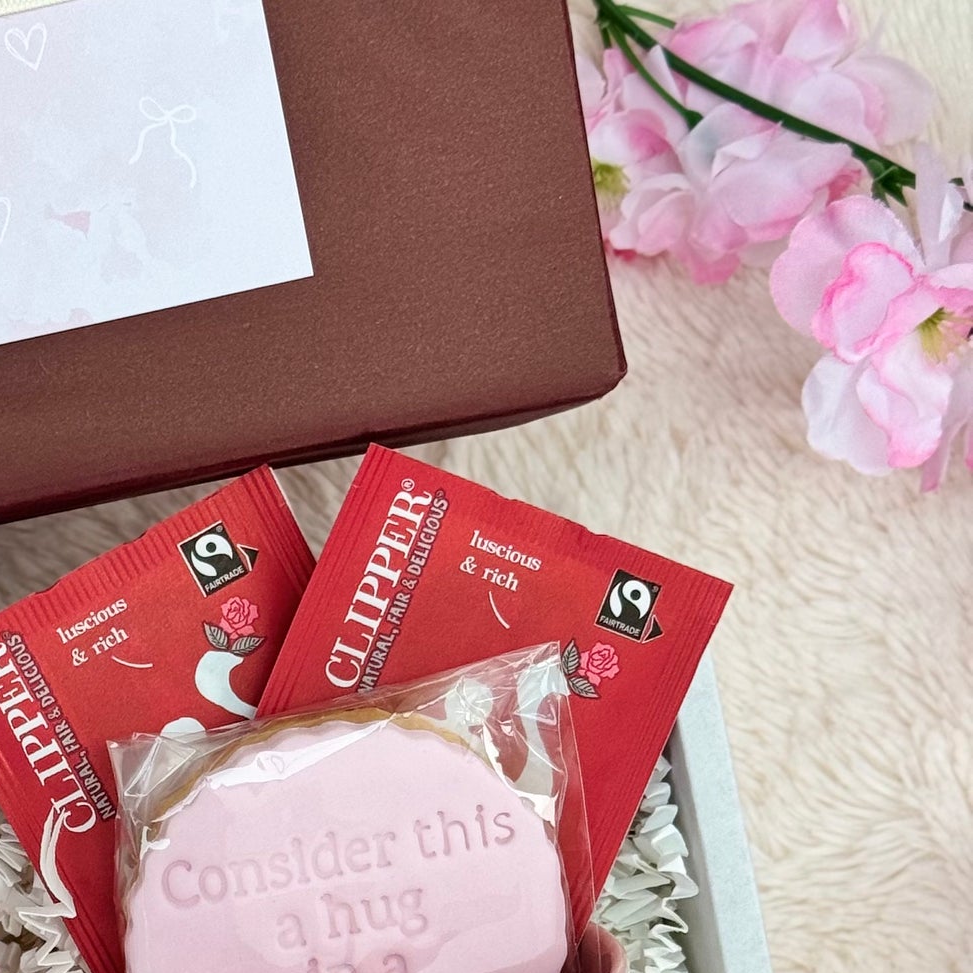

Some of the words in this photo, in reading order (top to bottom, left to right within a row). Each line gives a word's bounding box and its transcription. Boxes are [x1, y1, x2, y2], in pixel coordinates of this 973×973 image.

[469, 530, 542, 572] luscious
[204, 565, 245, 592] FAIRTRADE
[459, 556, 477, 574] &
[481, 565, 520, 592] rich
[56, 597, 128, 644] luscious
[387, 592, 411, 625] FAIR
[401, 579, 418, 590] &
[71, 648, 89, 667] &
[91, 626, 130, 657] rich
[599, 615, 641, 637] FAIRTRADE
[48, 708, 61, 720] &
[55, 720, 81, 753] FAIR
[161, 830, 396, 909] Consider
[413, 804, 516, 860] this
[275, 909, 307, 949] a
[320, 887, 429, 938] hug
